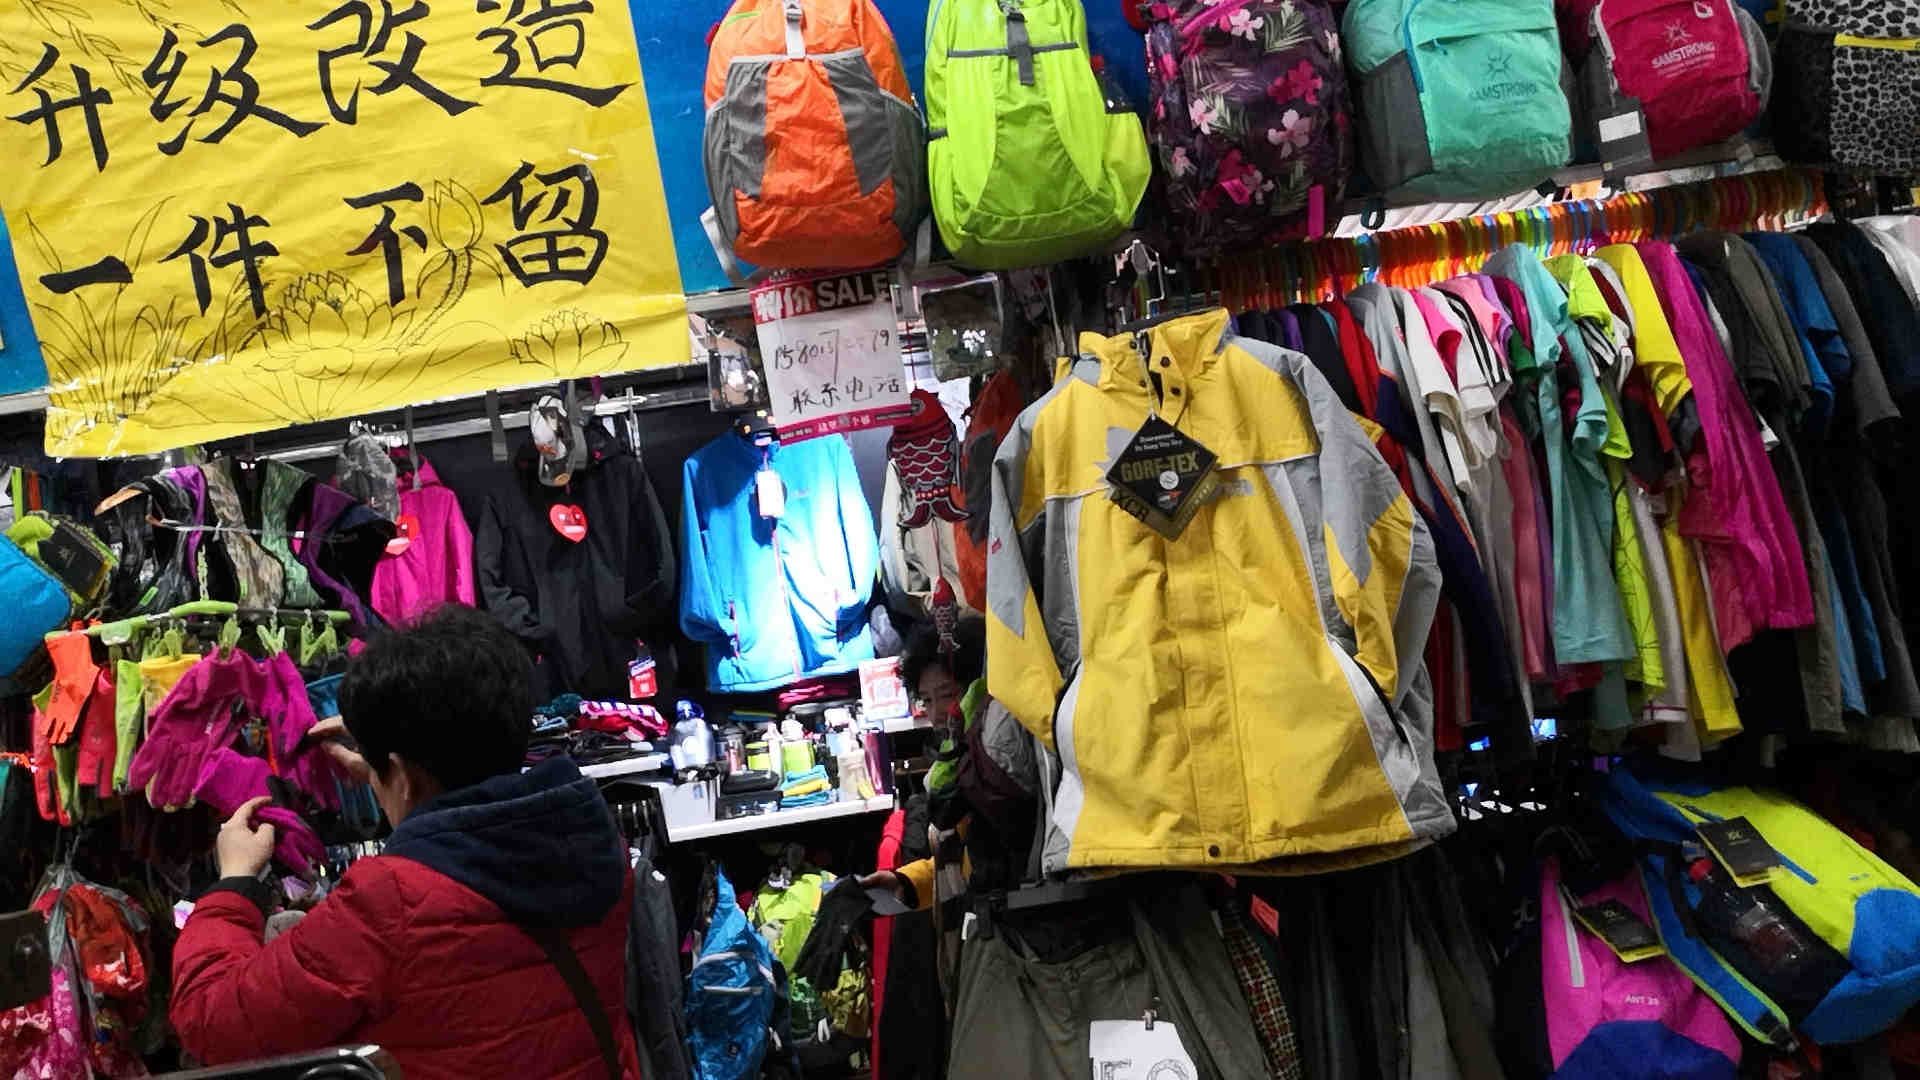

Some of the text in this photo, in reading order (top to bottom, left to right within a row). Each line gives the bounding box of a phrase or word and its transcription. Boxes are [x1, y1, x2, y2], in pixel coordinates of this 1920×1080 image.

[1651, 41, 1716, 68] SAMSTRONG
[5, 0, 635, 173] 升级改造
[39, 159, 609, 319] 一件不留
[816, 273, 890, 307] SALE
[1120, 451, 1200, 482] GORE-TEX
